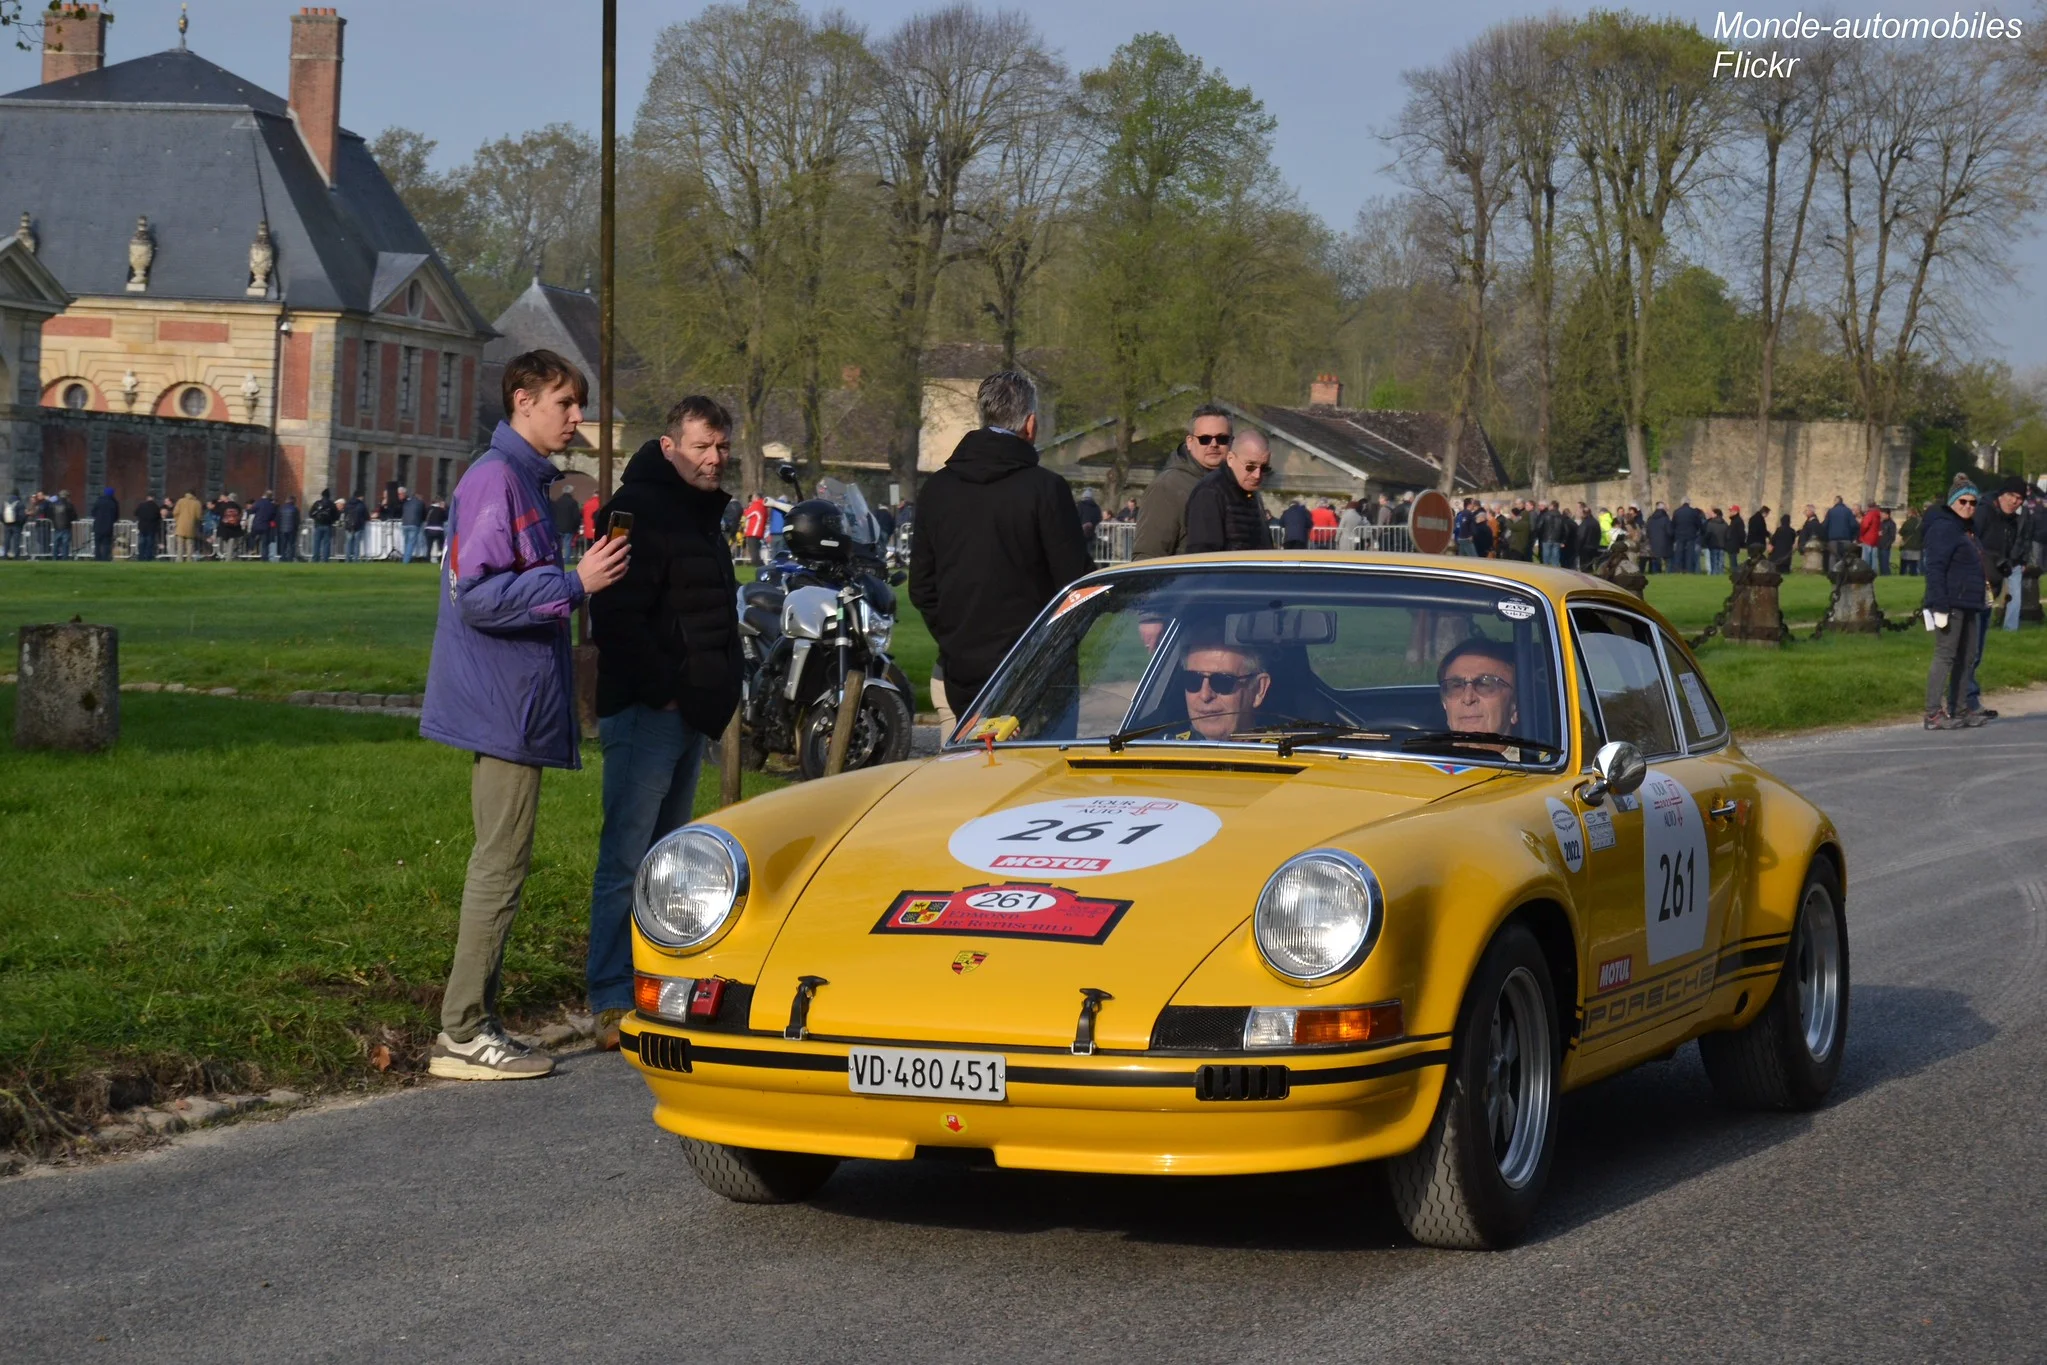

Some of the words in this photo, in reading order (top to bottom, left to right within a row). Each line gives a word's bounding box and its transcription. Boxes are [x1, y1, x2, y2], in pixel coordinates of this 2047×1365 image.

[997, 818, 1164, 845] 261
[1563, 839, 1581, 862] 2022
[996, 856, 1105, 870] MOTUL
[1658, 847, 1695, 922] 261
[973, 891, 1043, 910] 261
[950, 910, 1020, 920] EDMOND
[942, 919, 964, 927] DE
[967, 919, 1074, 933] ROTHSCHILD
[1599, 958, 1631, 988] MOTUL
[1588, 962, 1715, 1030] PORSCHE
[478, 1046, 506, 1066] N
